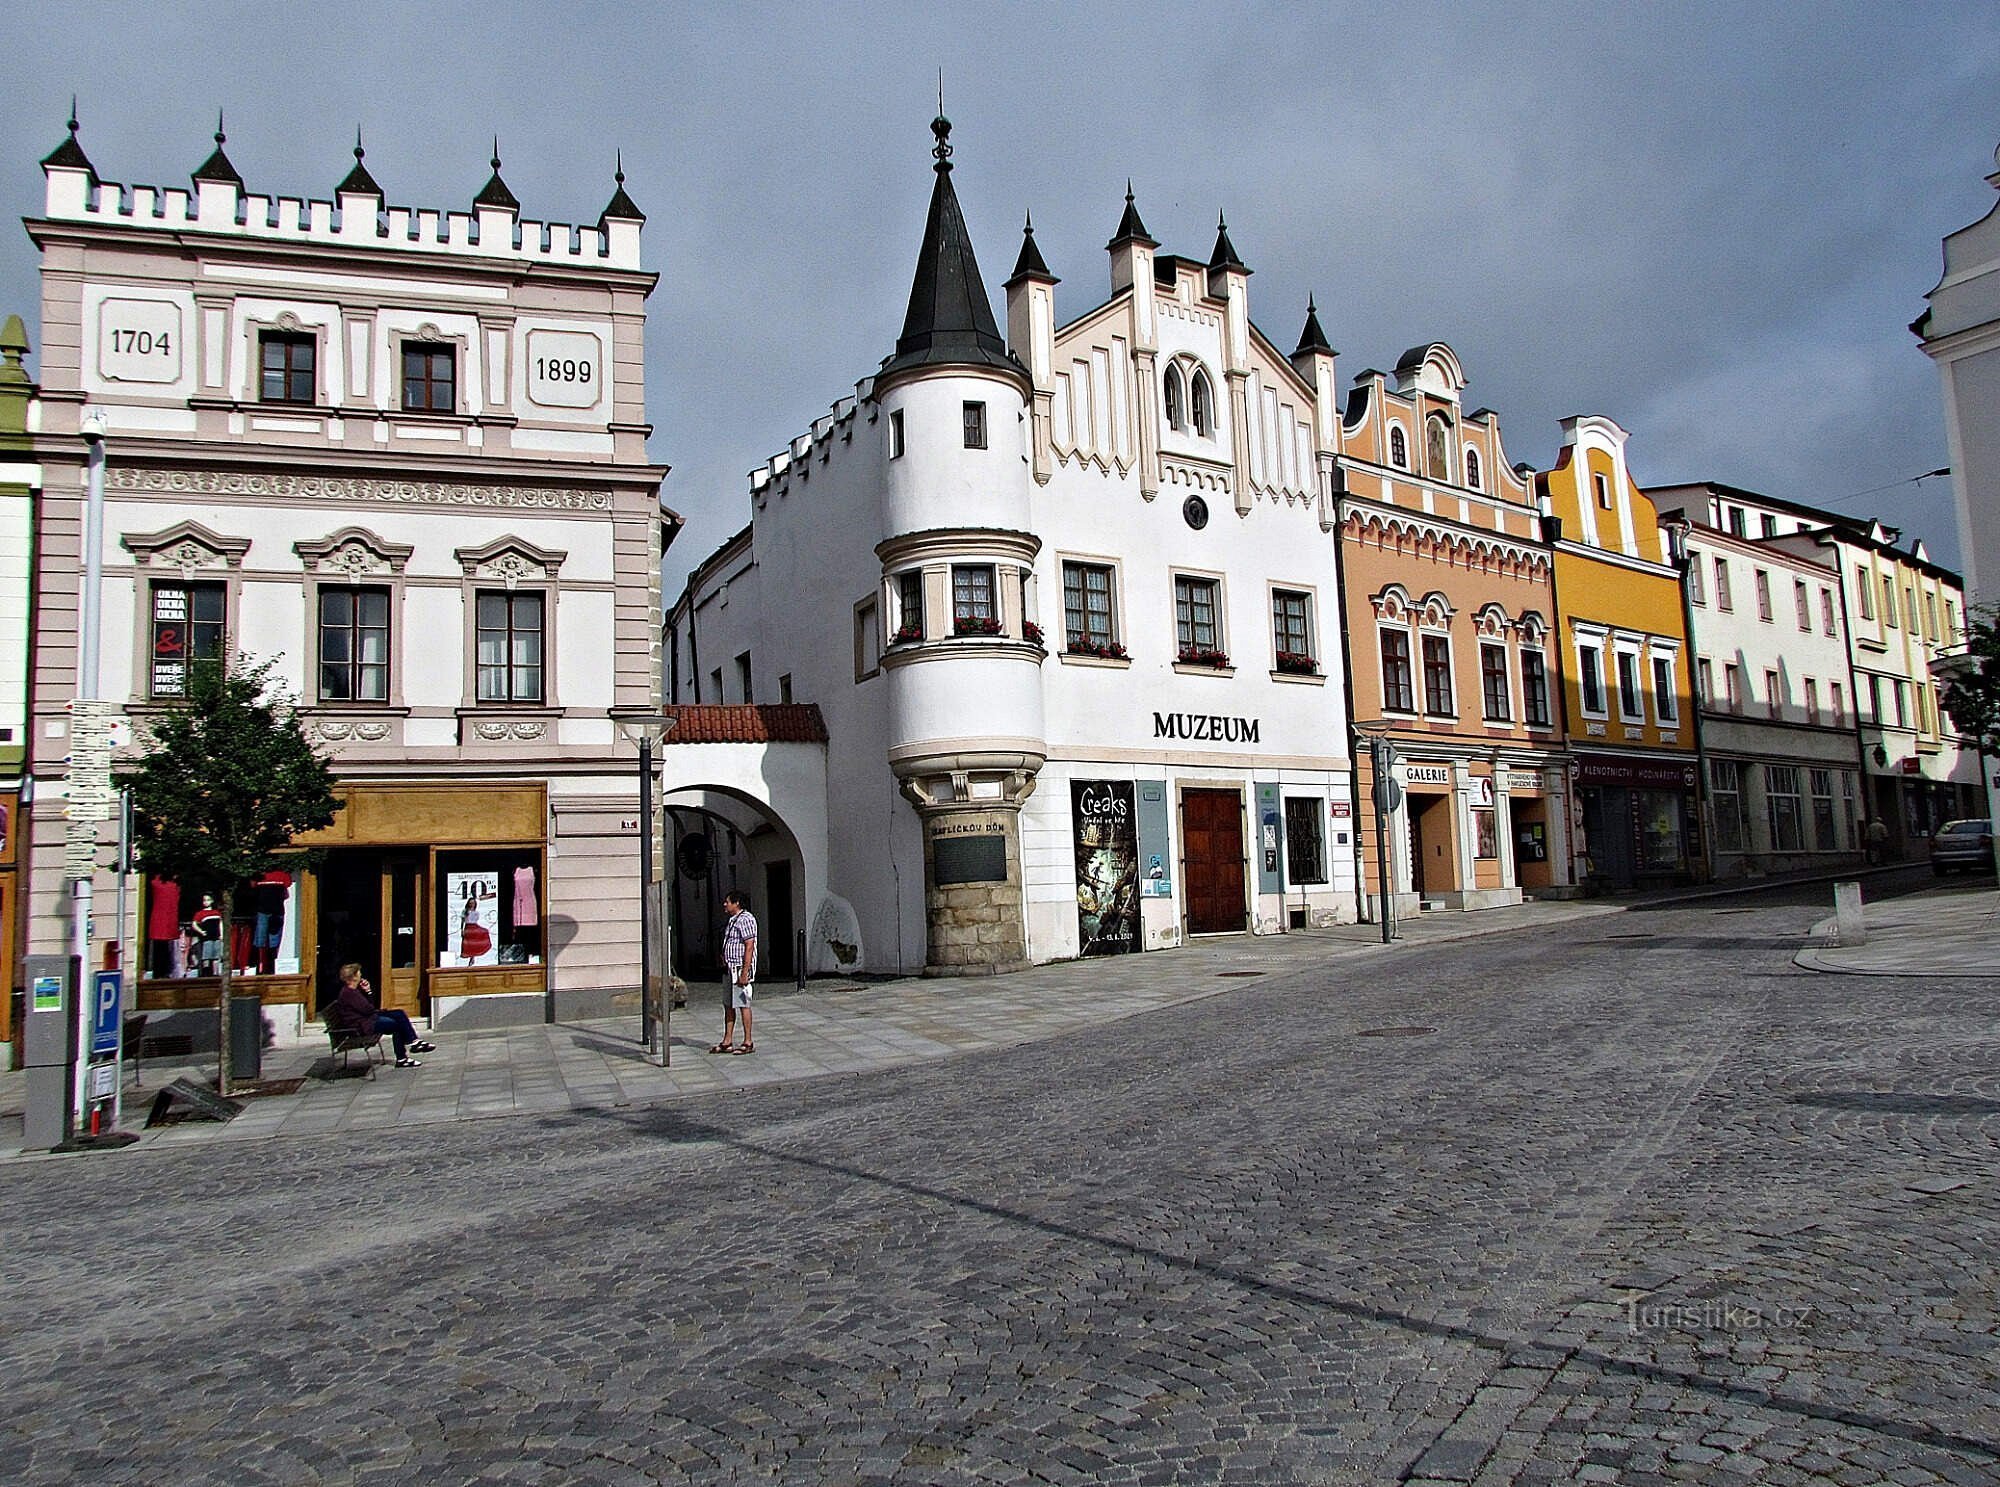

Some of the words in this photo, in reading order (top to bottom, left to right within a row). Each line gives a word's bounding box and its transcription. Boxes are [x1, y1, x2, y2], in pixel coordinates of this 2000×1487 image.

[112, 329, 170, 355] 1704
[537, 358, 591, 383] 1899
[156, 609, 185, 619] OKNA
[157, 599, 186, 609] OKNA
[1152, 712, 1260, 743] MUZEUM
[1406, 768, 1448, 781] GALERIE
[1080, 784, 1127, 815] Creaks
[99, 982, 116, 1027] P
